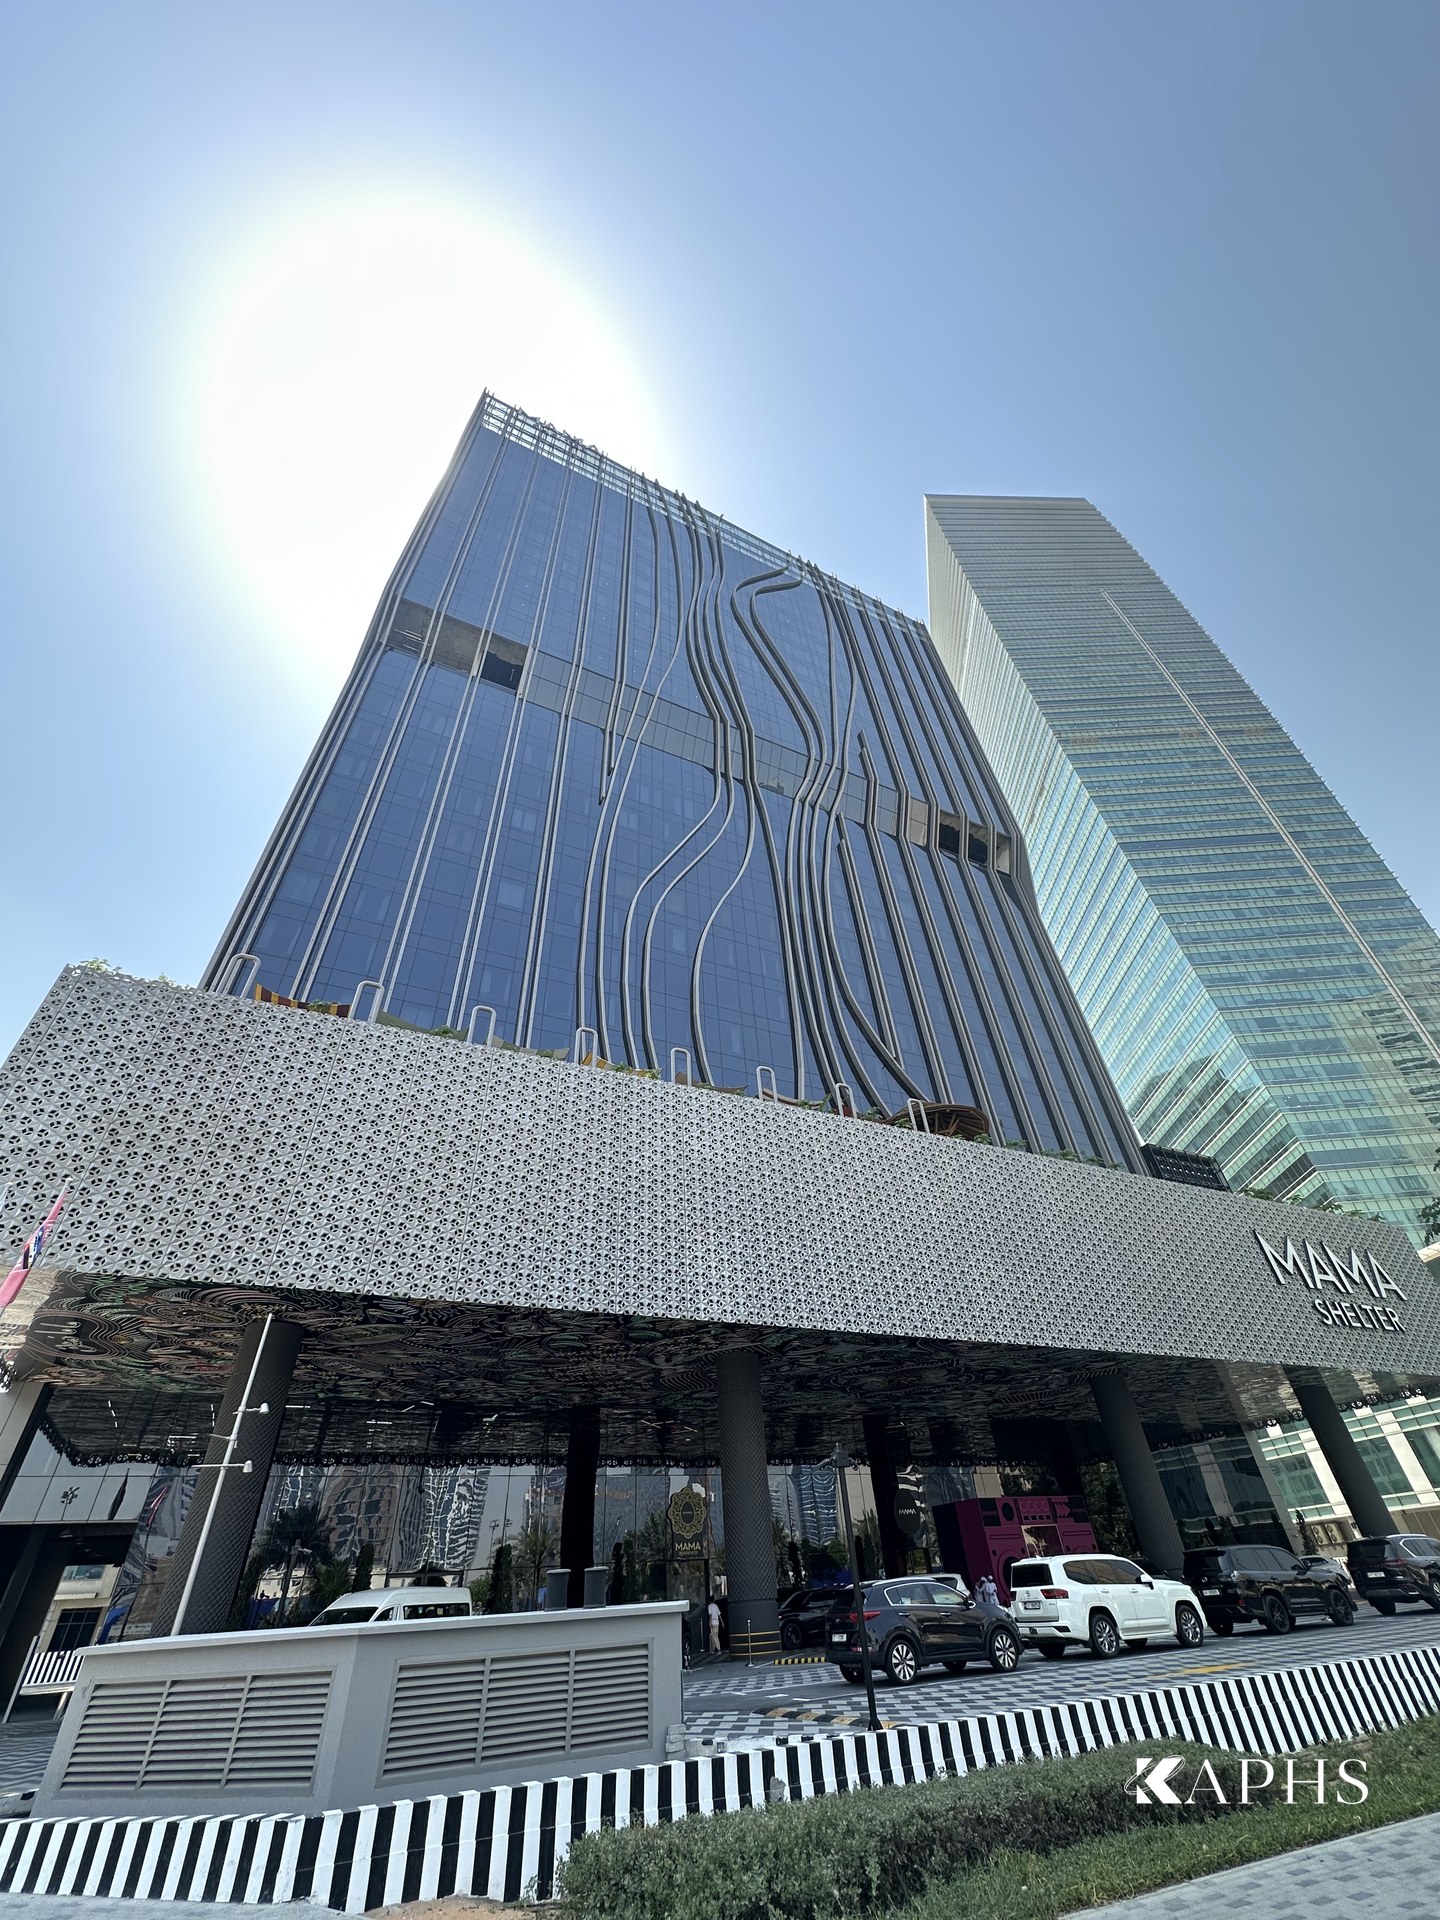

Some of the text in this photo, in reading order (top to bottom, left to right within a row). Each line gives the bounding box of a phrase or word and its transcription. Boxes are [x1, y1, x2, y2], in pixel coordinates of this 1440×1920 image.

[1253, 1230, 1407, 1300] MAMA
[1314, 1298, 1406, 1332] SHELTER
[675, 1541, 701, 1551] MAMA
